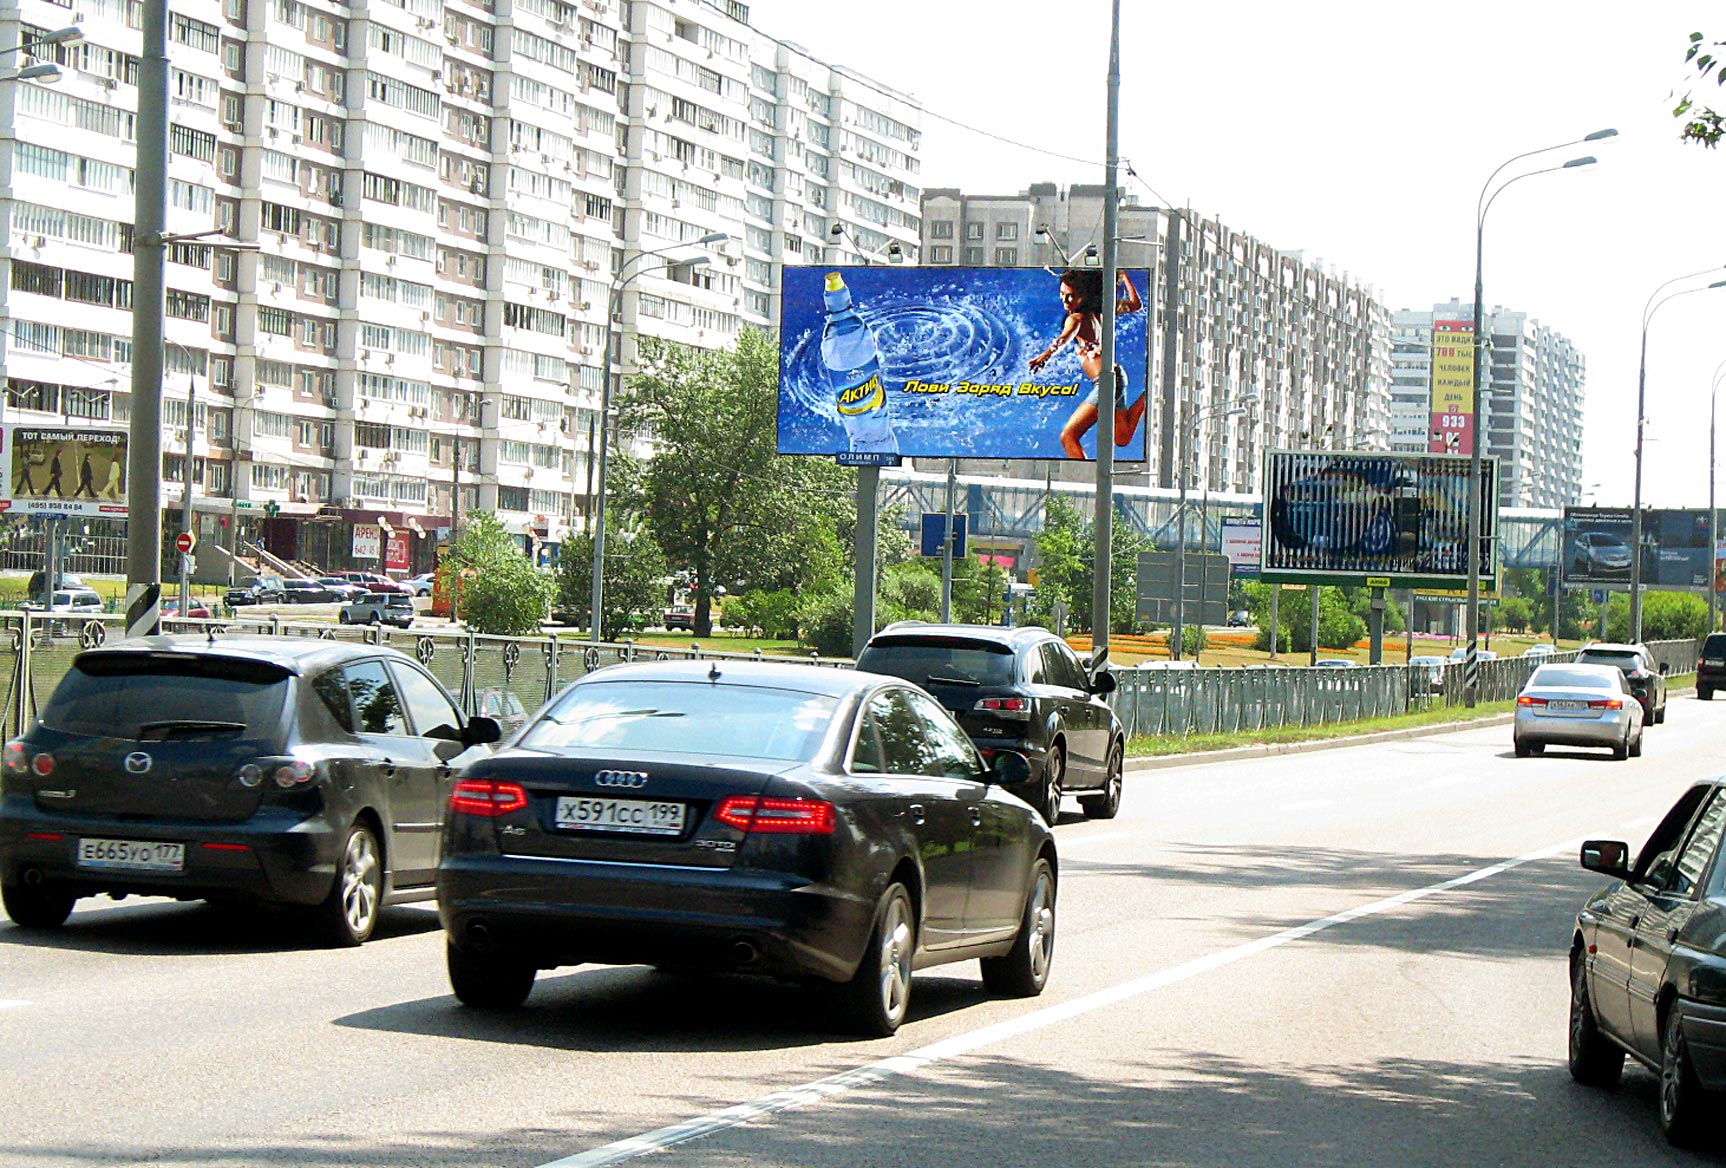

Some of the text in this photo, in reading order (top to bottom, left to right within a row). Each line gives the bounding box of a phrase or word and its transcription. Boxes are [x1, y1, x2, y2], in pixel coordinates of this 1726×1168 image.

[1437, 347, 1455, 358] 700
[1440, 364, 1471, 372] ЧЕЛОВЕК
[1437, 378, 1471, 387] КАЖДЫЙ
[903, 380, 1080, 398] Лови Заряд Вкуса!
[1444, 393, 1464, 401] ДЕНЬ
[1442, 415, 1466, 428] 933
[22, 431, 38, 440] ТОТ
[40, 431, 74, 441] САМЫЙ
[839, 452, 880, 462] ОЛИМП
[649, 804, 680, 816] 199
[154, 844, 180, 858] 177
